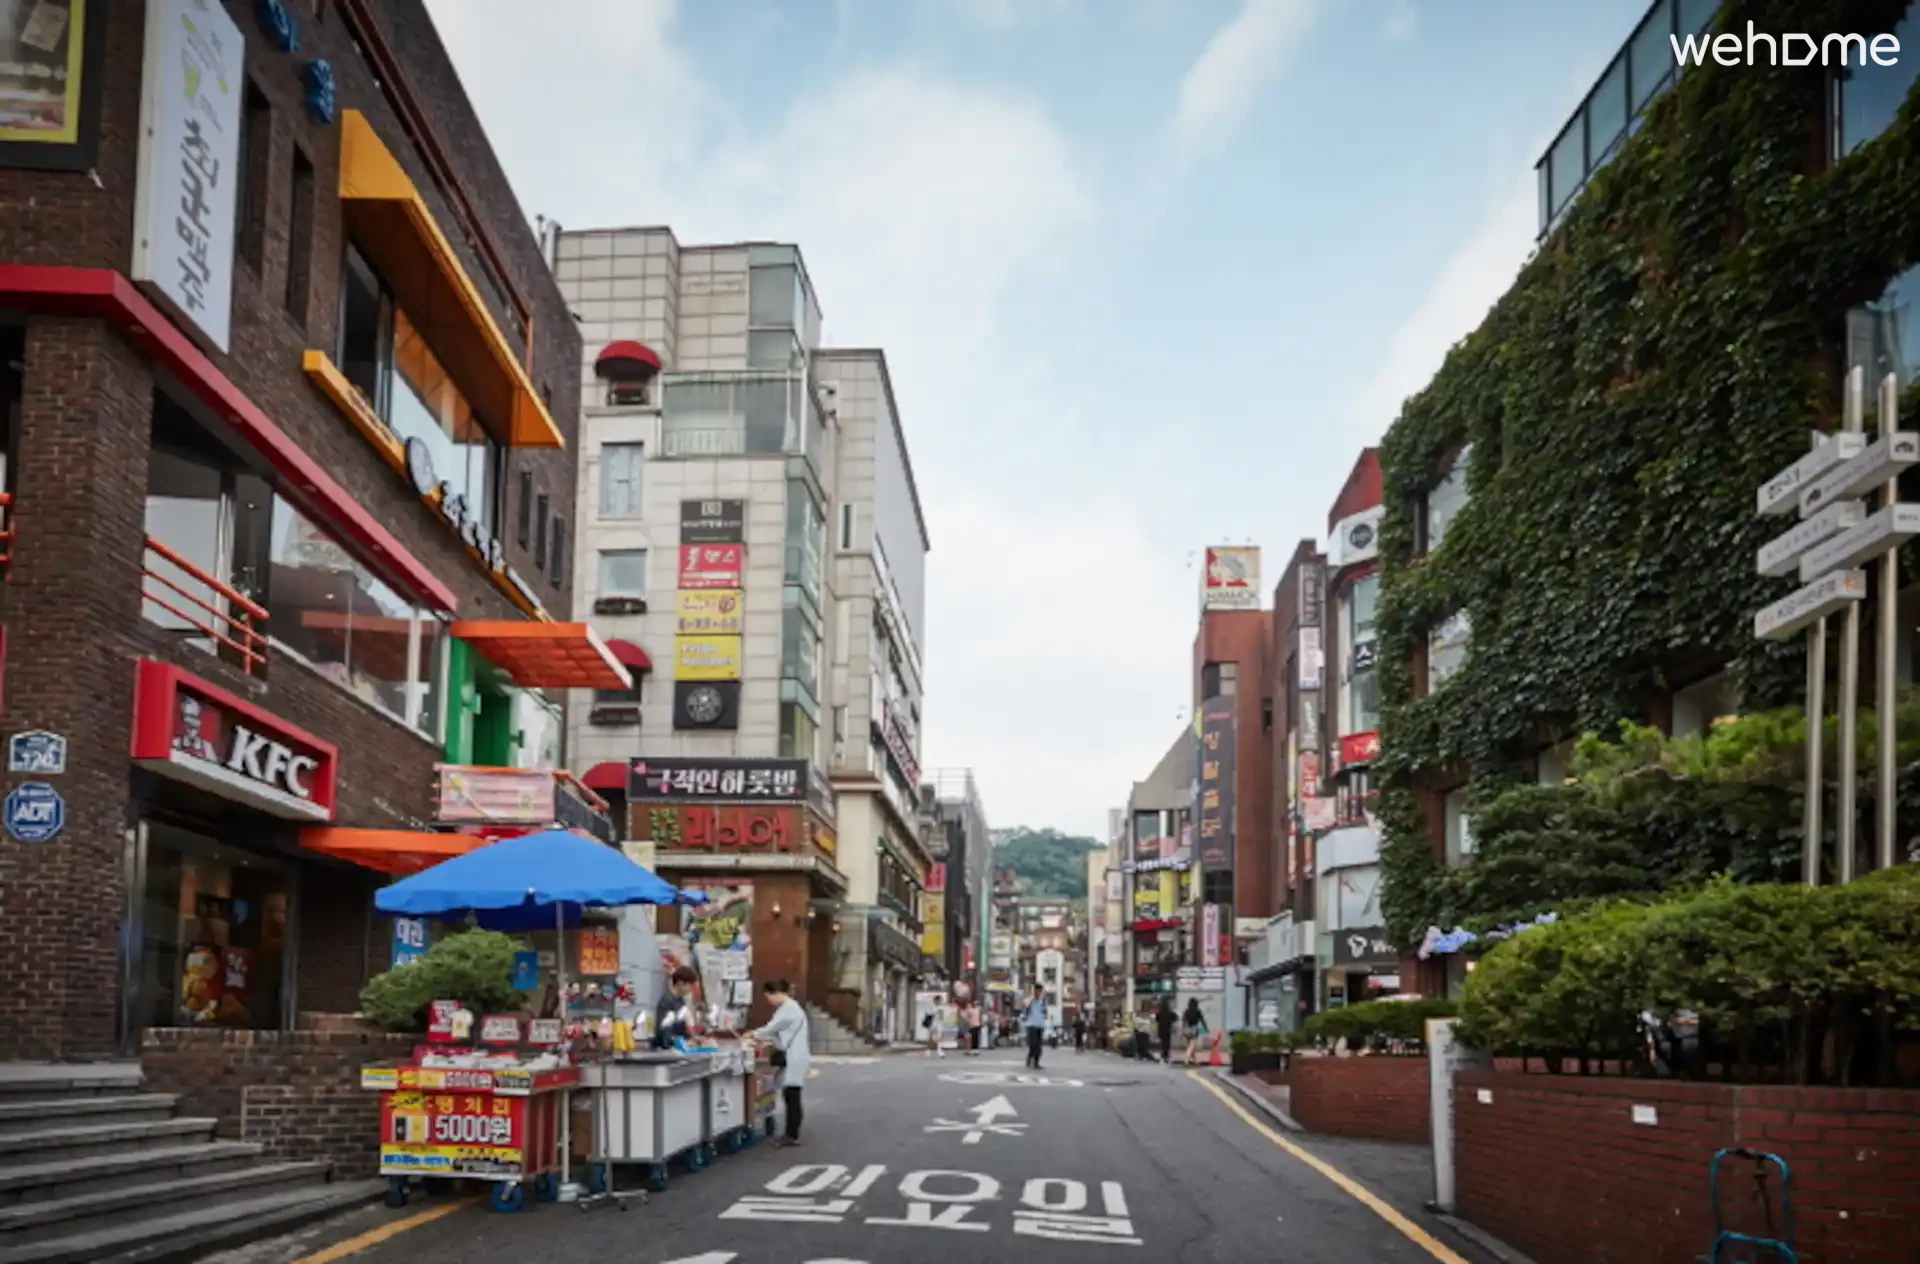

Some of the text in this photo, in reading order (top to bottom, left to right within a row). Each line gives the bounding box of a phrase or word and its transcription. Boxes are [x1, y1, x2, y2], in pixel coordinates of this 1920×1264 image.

[227, 725, 319, 797] KFC
[13, 801, 54, 821] ADT
[435, 1114, 512, 1144] 5000원
[718, 1163, 1143, 1246] 일요일
